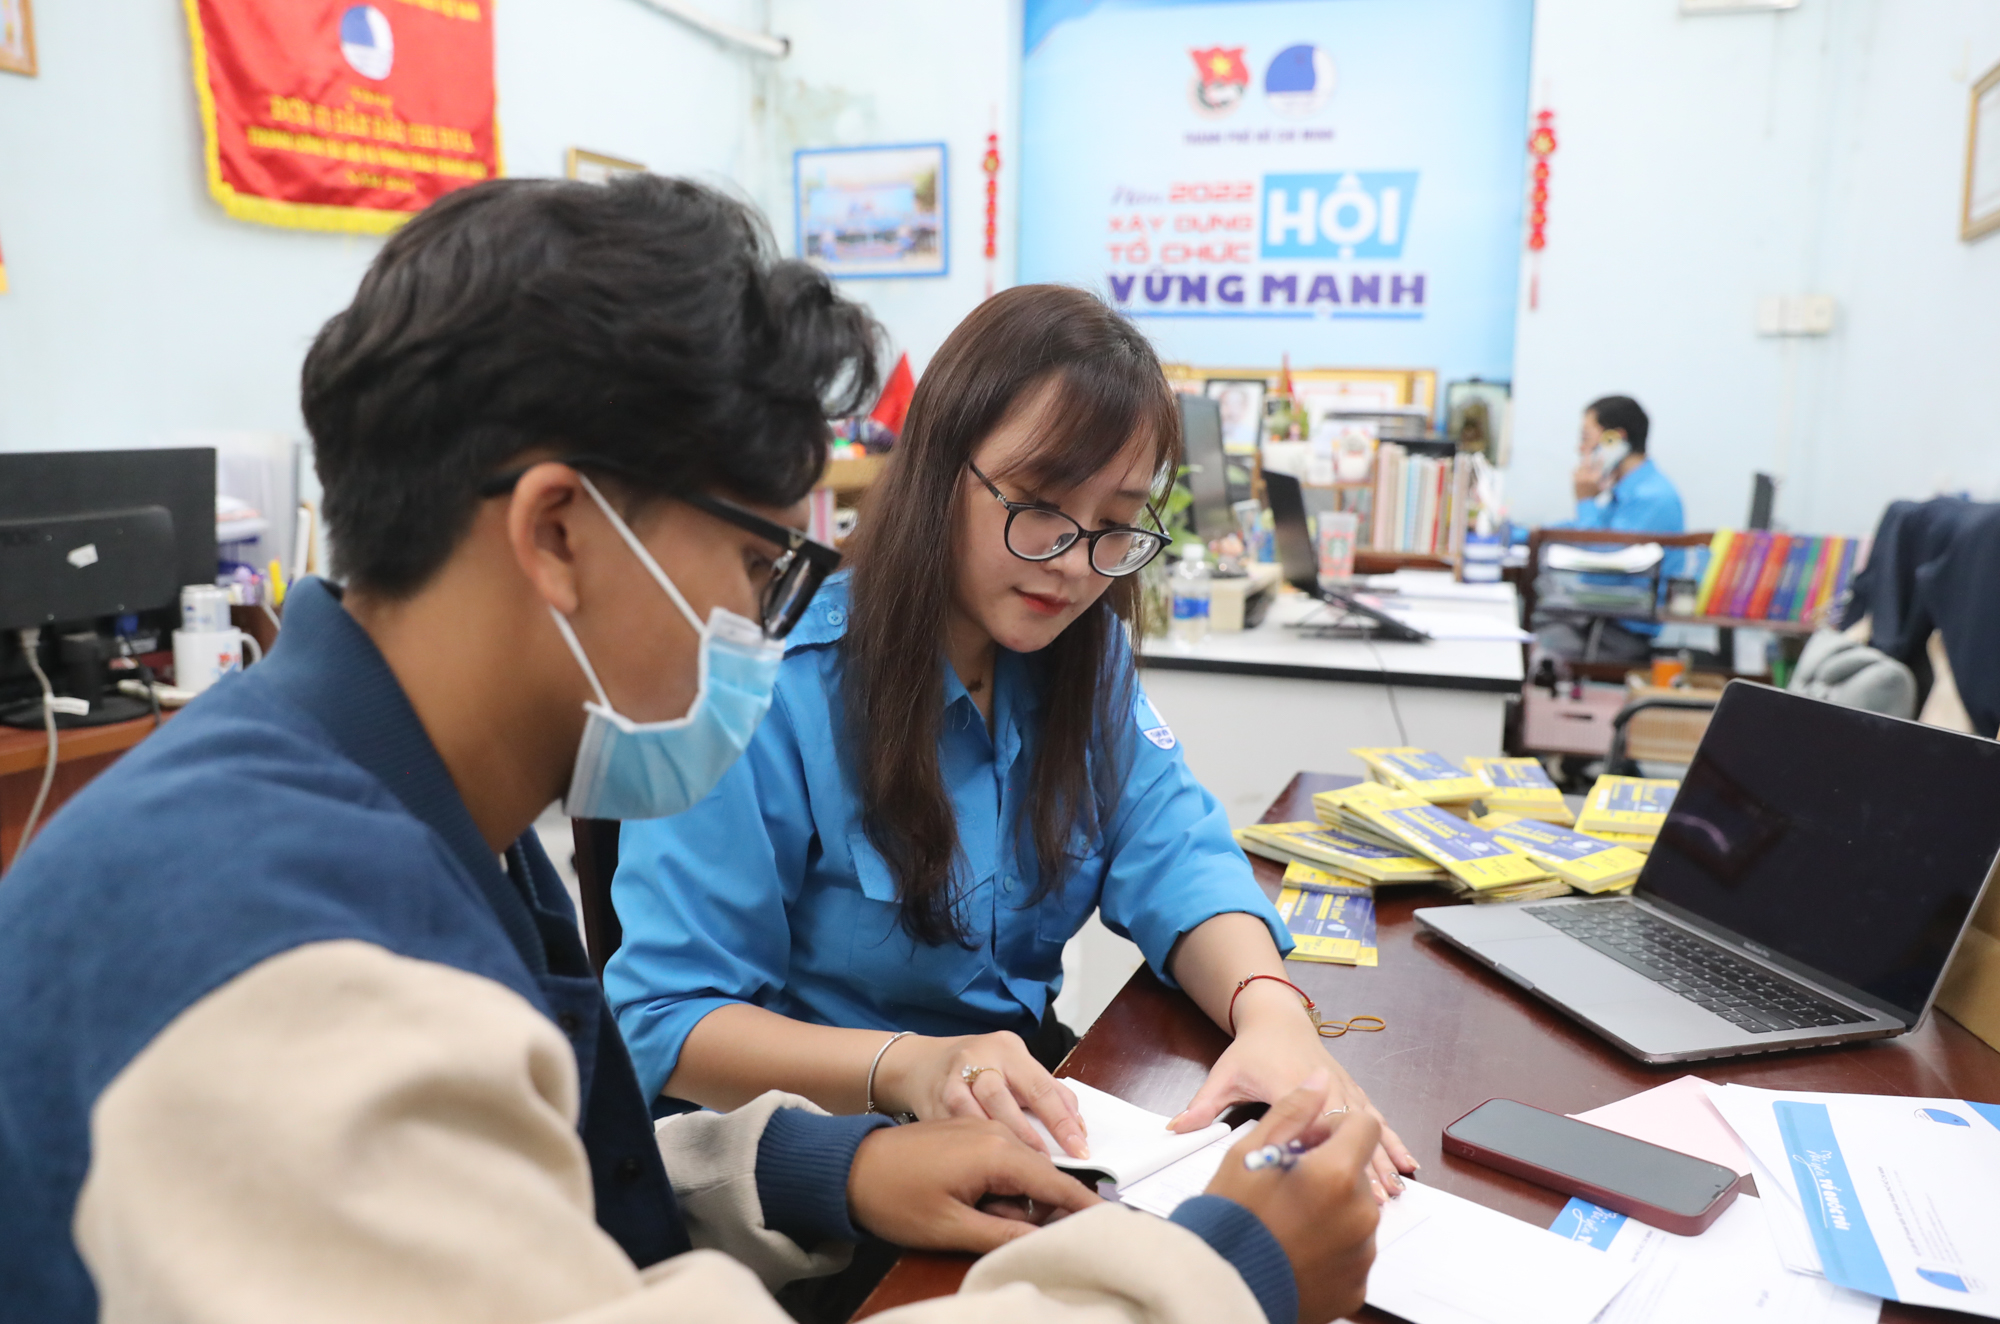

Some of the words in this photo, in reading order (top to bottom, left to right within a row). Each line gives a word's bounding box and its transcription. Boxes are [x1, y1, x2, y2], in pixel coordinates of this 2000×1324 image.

[1169, 182, 1254, 203] 2022
[1107, 213, 1165, 232] XÂY
[1267, 172, 1402, 259] HỘI
[1108, 266, 1245, 304] VỮNG
[1262, 275, 1425, 315] MẠNH
